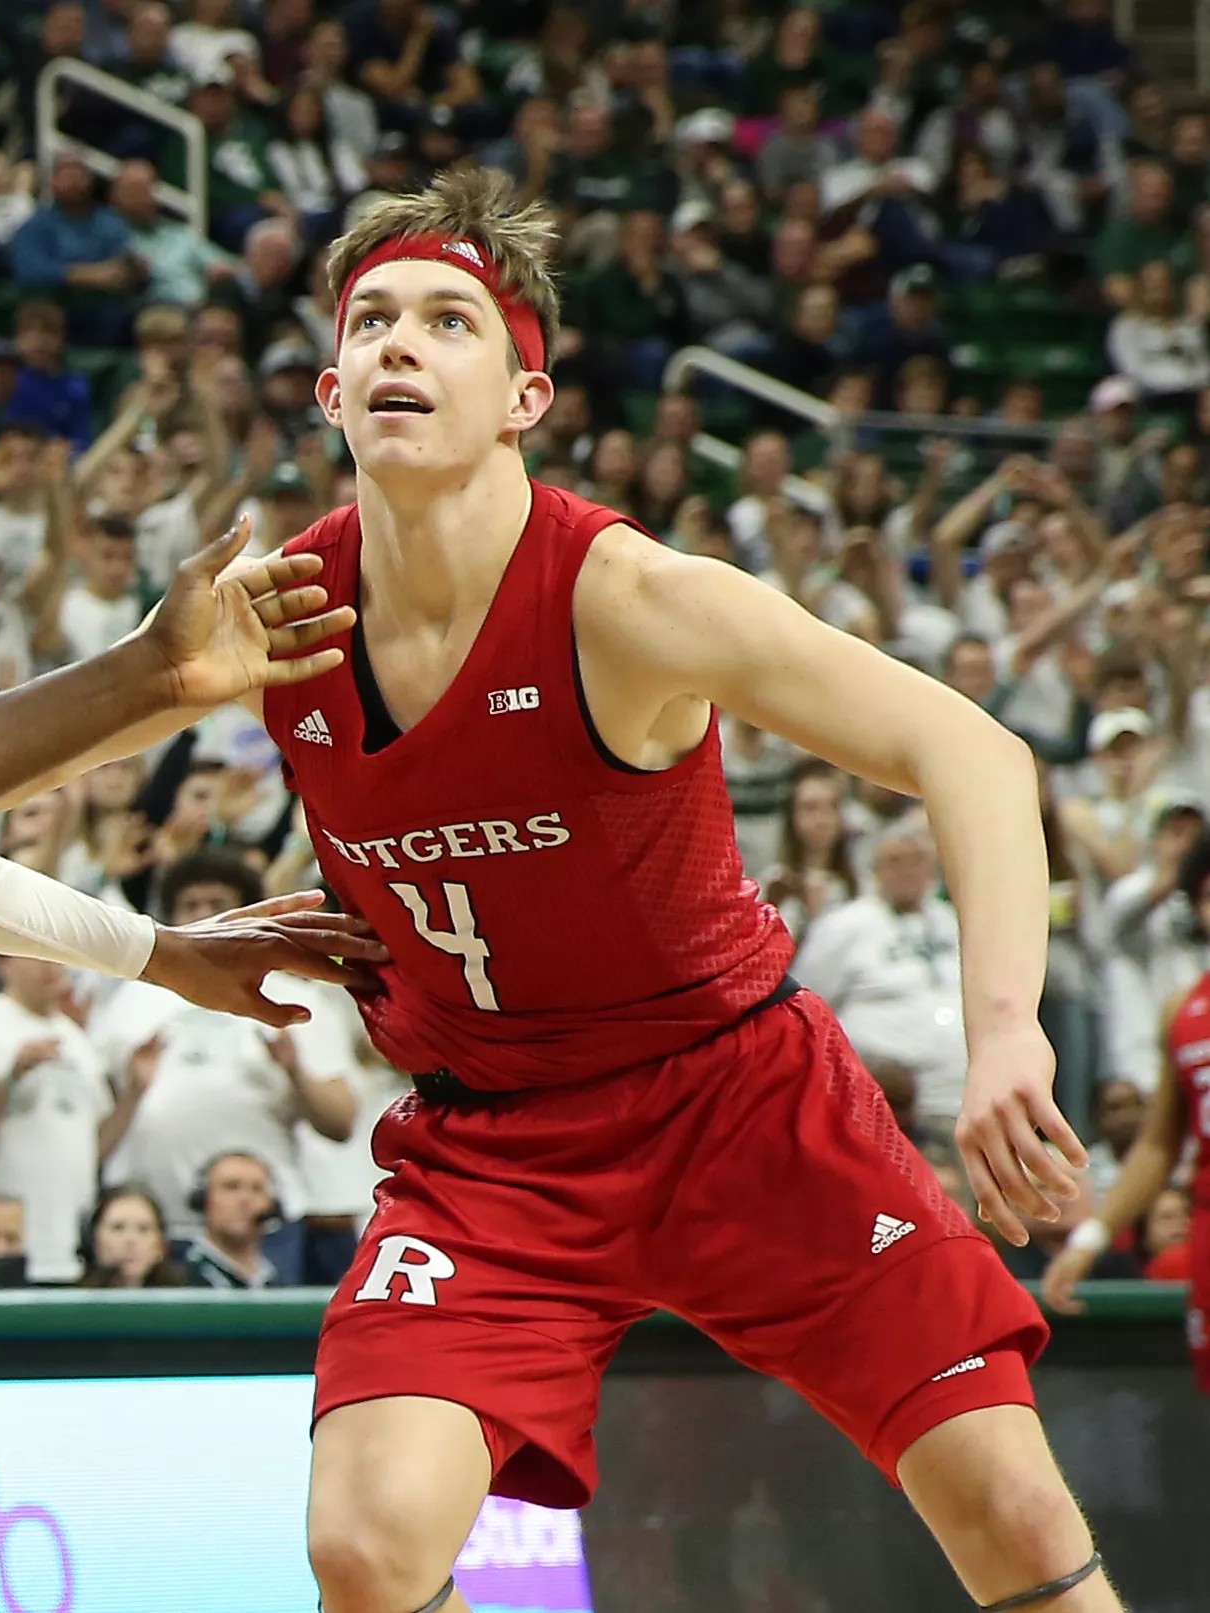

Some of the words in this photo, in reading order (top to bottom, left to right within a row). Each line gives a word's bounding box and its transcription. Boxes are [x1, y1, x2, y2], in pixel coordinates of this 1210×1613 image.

[388, 882, 500, 1012] 4
[353, 1234, 457, 1307] R
[870, 1221, 917, 1254] adidas
